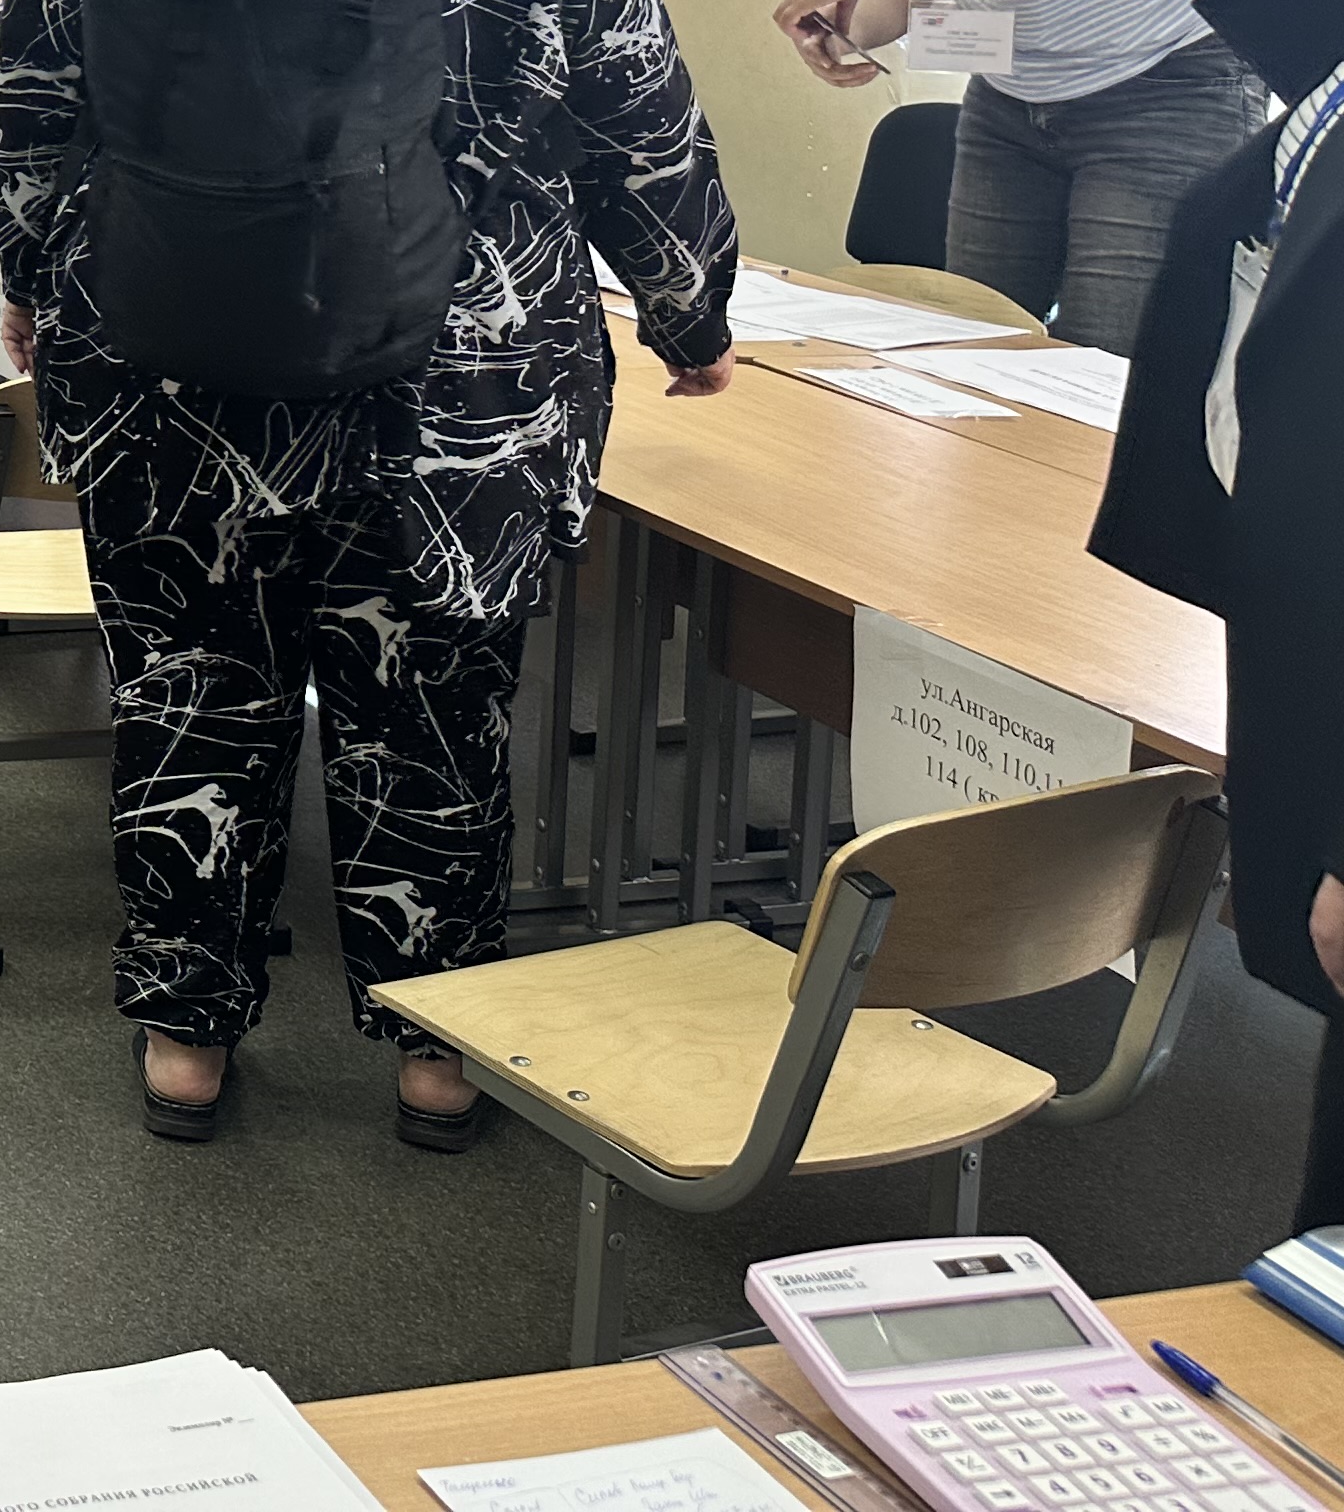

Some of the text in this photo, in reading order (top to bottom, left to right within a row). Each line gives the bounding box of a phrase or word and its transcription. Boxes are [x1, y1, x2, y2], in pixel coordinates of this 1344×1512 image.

[920, 677, 1055, 755] ул.Ангарская
[890, 704, 947, 748] д.102,
[956, 729, 994, 770] 108,
[926, 755, 958, 789] 114
[787, 1268, 855, 1285] BRAUBERG
[141, 1472, 260, 1498] РОССИЙСКОЙ
[1133, 1467, 1155, 1485] 6
